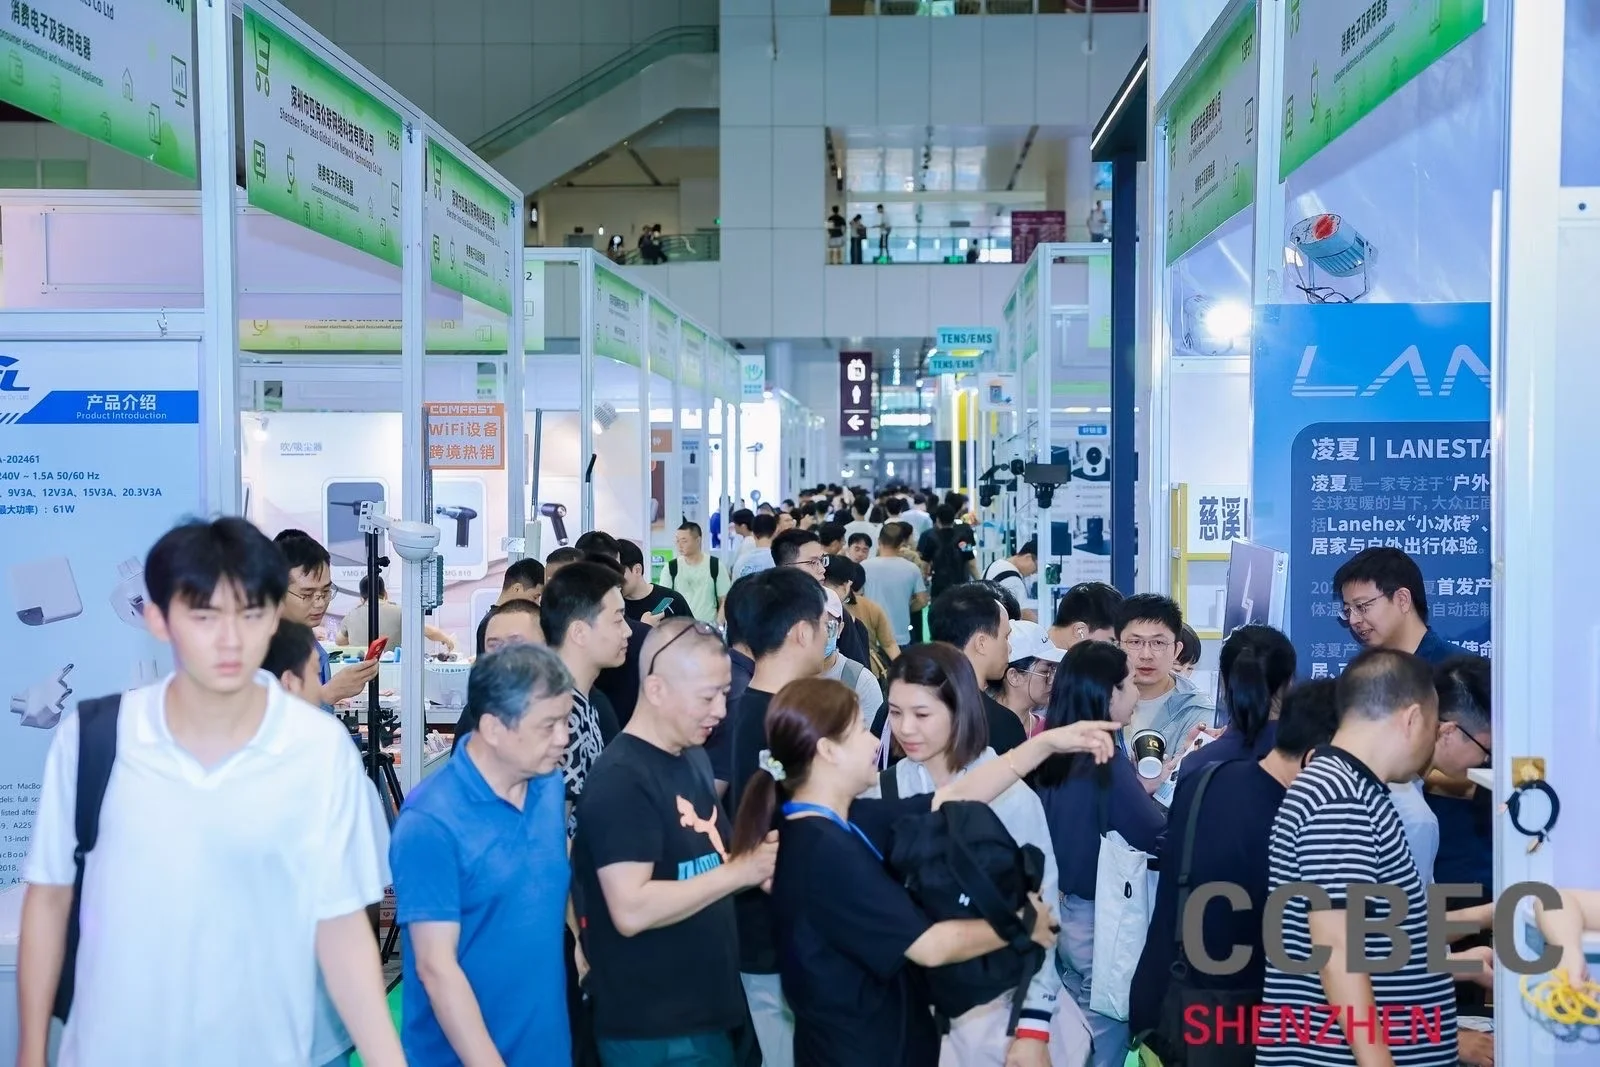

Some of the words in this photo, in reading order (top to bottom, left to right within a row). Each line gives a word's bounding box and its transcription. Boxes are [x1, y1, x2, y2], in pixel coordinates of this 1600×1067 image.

[11, 0, 91, 61] 消费电子及家用电器
[942, 334, 992, 344] TENS/EMS
[933, 359, 974, 368] TENS/EMS
[87, 394, 157, 411] 产品介绍
[430, 405, 496, 414] COMFAST
[76, 412, 110, 420] Product
[112, 411, 167, 420] Introduction
[429, 421, 498, 437] WiFi设备
[429, 444, 495, 460] 跨境热销
[1311, 437, 1360, 461] 凌夏
[0, 471, 20, 480] 40V
[33, 471, 54, 480] 1.5A
[57, 471, 84, 481] 50/60
[87, 471, 100, 480] Hz
[53, 505, 75, 513] 61W
[1199, 496, 1248, 541] 慈溪
[1428, 602, 1491, 617] 自动控制
